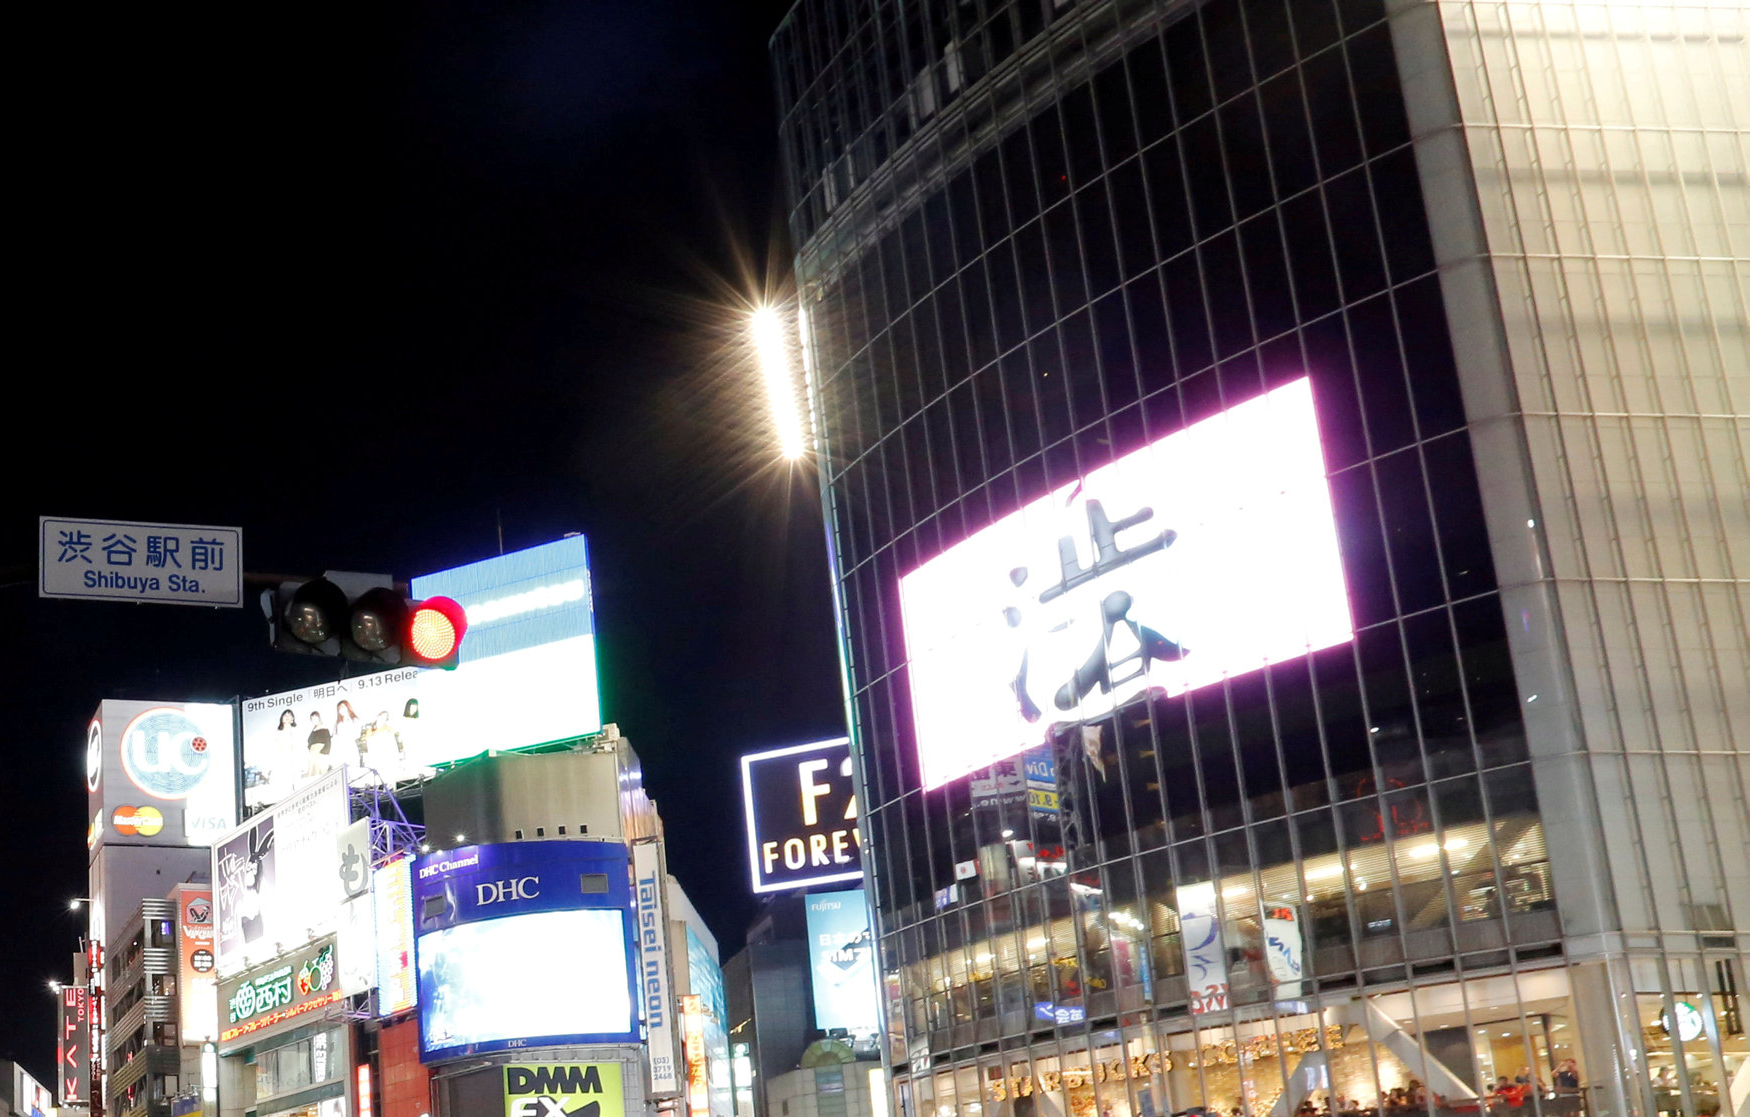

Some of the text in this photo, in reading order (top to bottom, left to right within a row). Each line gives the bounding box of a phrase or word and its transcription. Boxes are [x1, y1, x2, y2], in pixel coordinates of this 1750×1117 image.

[58, 530, 224, 572] 渋谷駅前
[83, 570, 206, 594] Shibuya Sta.
[247, 700, 265, 712] 9th
[266, 693, 304, 709] Single
[313, 685, 348, 699] 明日へ
[357, 676, 382, 690] 9.13
[191, 817, 227, 829] VISA
[419, 853, 479, 880] DHC Channel
[476, 876, 540, 907] DHC
[811, 901, 842, 912] FUJITSU
[639, 870, 664, 1028] Taisei neon
[77, 988, 85, 1022] TOKYO
[256, 977, 292, 1013] 西村
[508, 1039, 527, 1048] DHC
[991, 1024, 1345, 1102] STARBUCKS COFFEE
[508, 1066, 604, 1095] DMM
